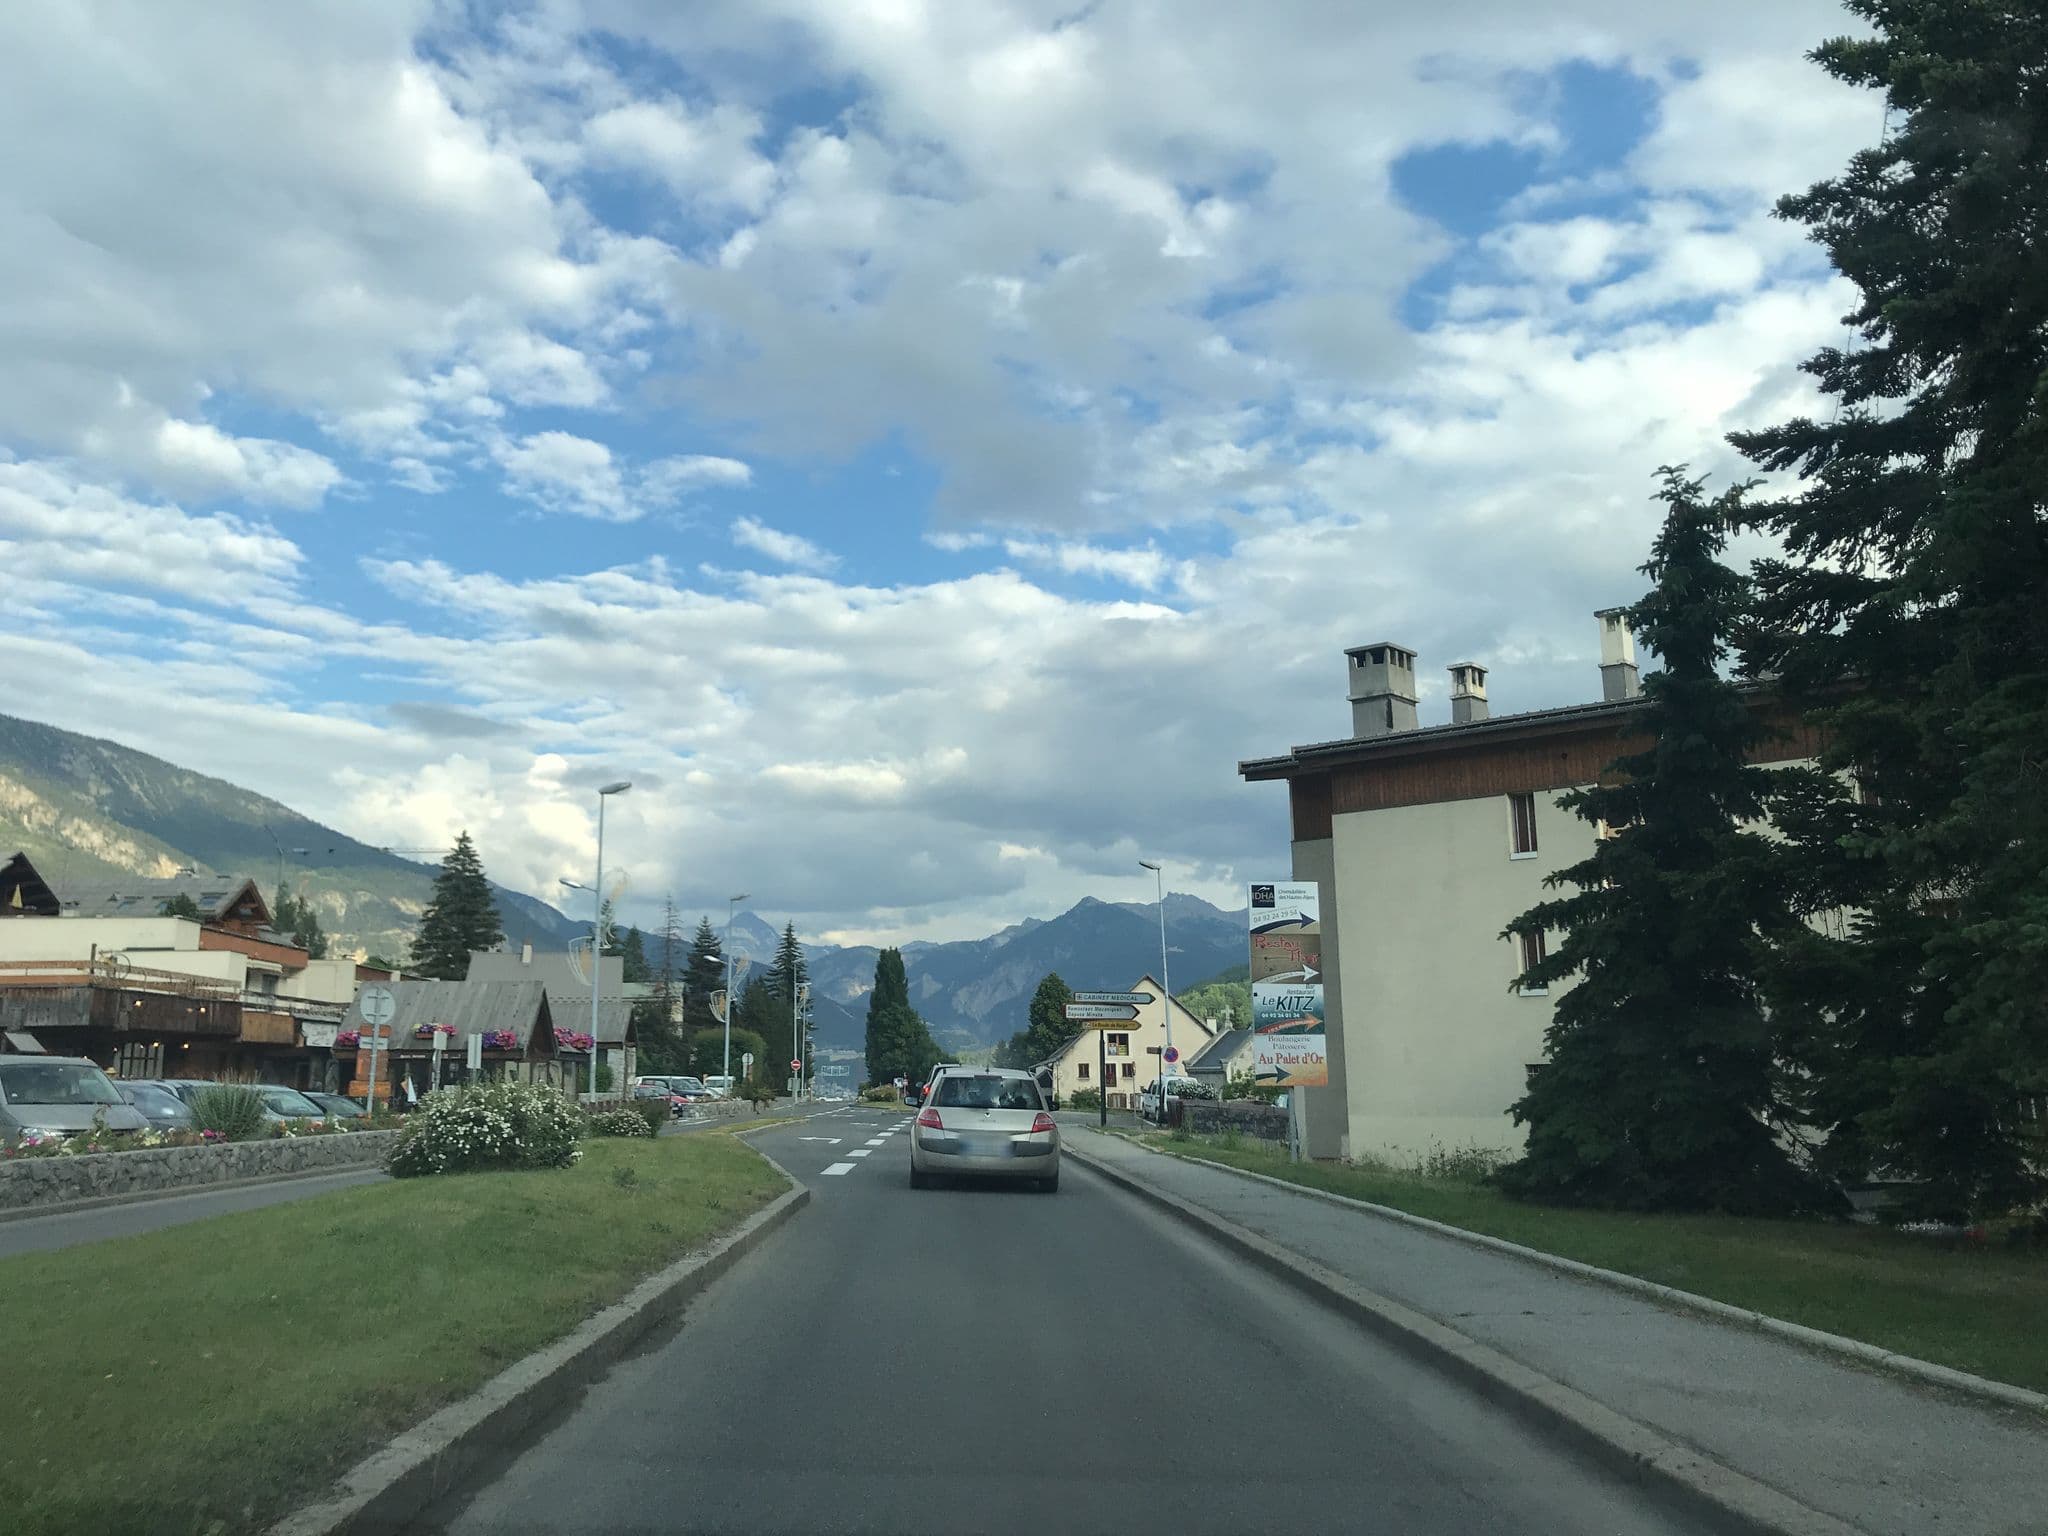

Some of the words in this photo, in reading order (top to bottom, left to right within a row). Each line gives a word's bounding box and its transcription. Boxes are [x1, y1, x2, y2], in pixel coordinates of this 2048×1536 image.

[1262, 996, 1275, 1006] Le
[1276, 996, 1315, 1011] KITZ
[1268, 1035, 1310, 1044] Boulangerie
[1259, 1053, 1273, 1064] Au
[1276, 1052, 1301, 1064] Palet
[1302, 1051, 1324, 1064] d'Or
